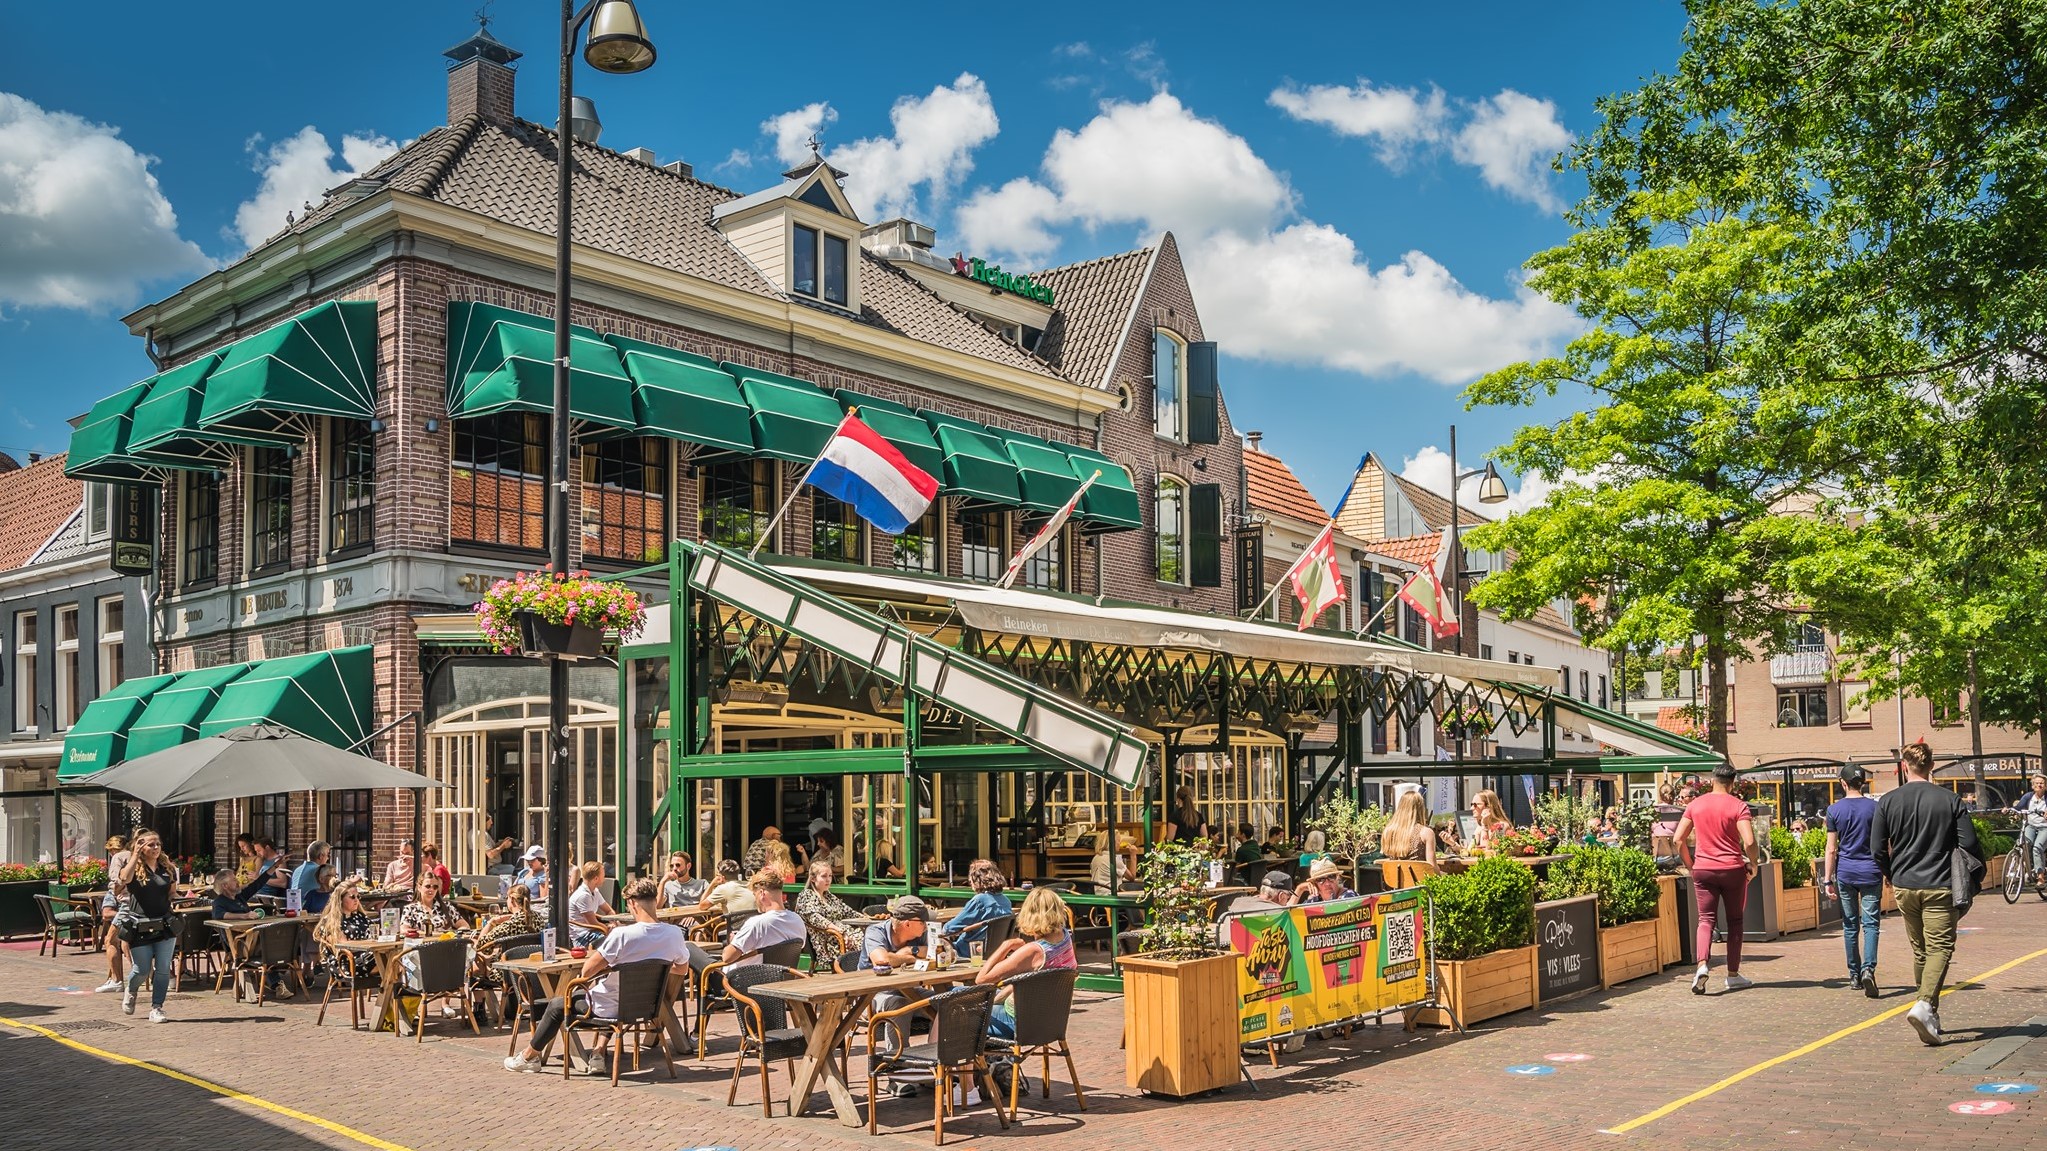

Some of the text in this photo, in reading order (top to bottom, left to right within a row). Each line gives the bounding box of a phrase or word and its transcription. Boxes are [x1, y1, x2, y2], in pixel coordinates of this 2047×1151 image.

[970, 257, 1054, 305] Heineken
[129, 485, 138, 539] EURS
[183, 576, 353, 623] anno DE BEURS 1874
[1003, 615, 1049, 633] Heineken
[1309, 910, 1356, 930] VOORGERECHTEN
[1260, 927, 1287, 948] Taste
[1306, 929, 1360, 949] HOOFDGERECHTEN
[1246, 941, 1289, 972] Away
[1547, 958, 1558, 976] VIS
[1563, 954, 1580, 974] VLEES
